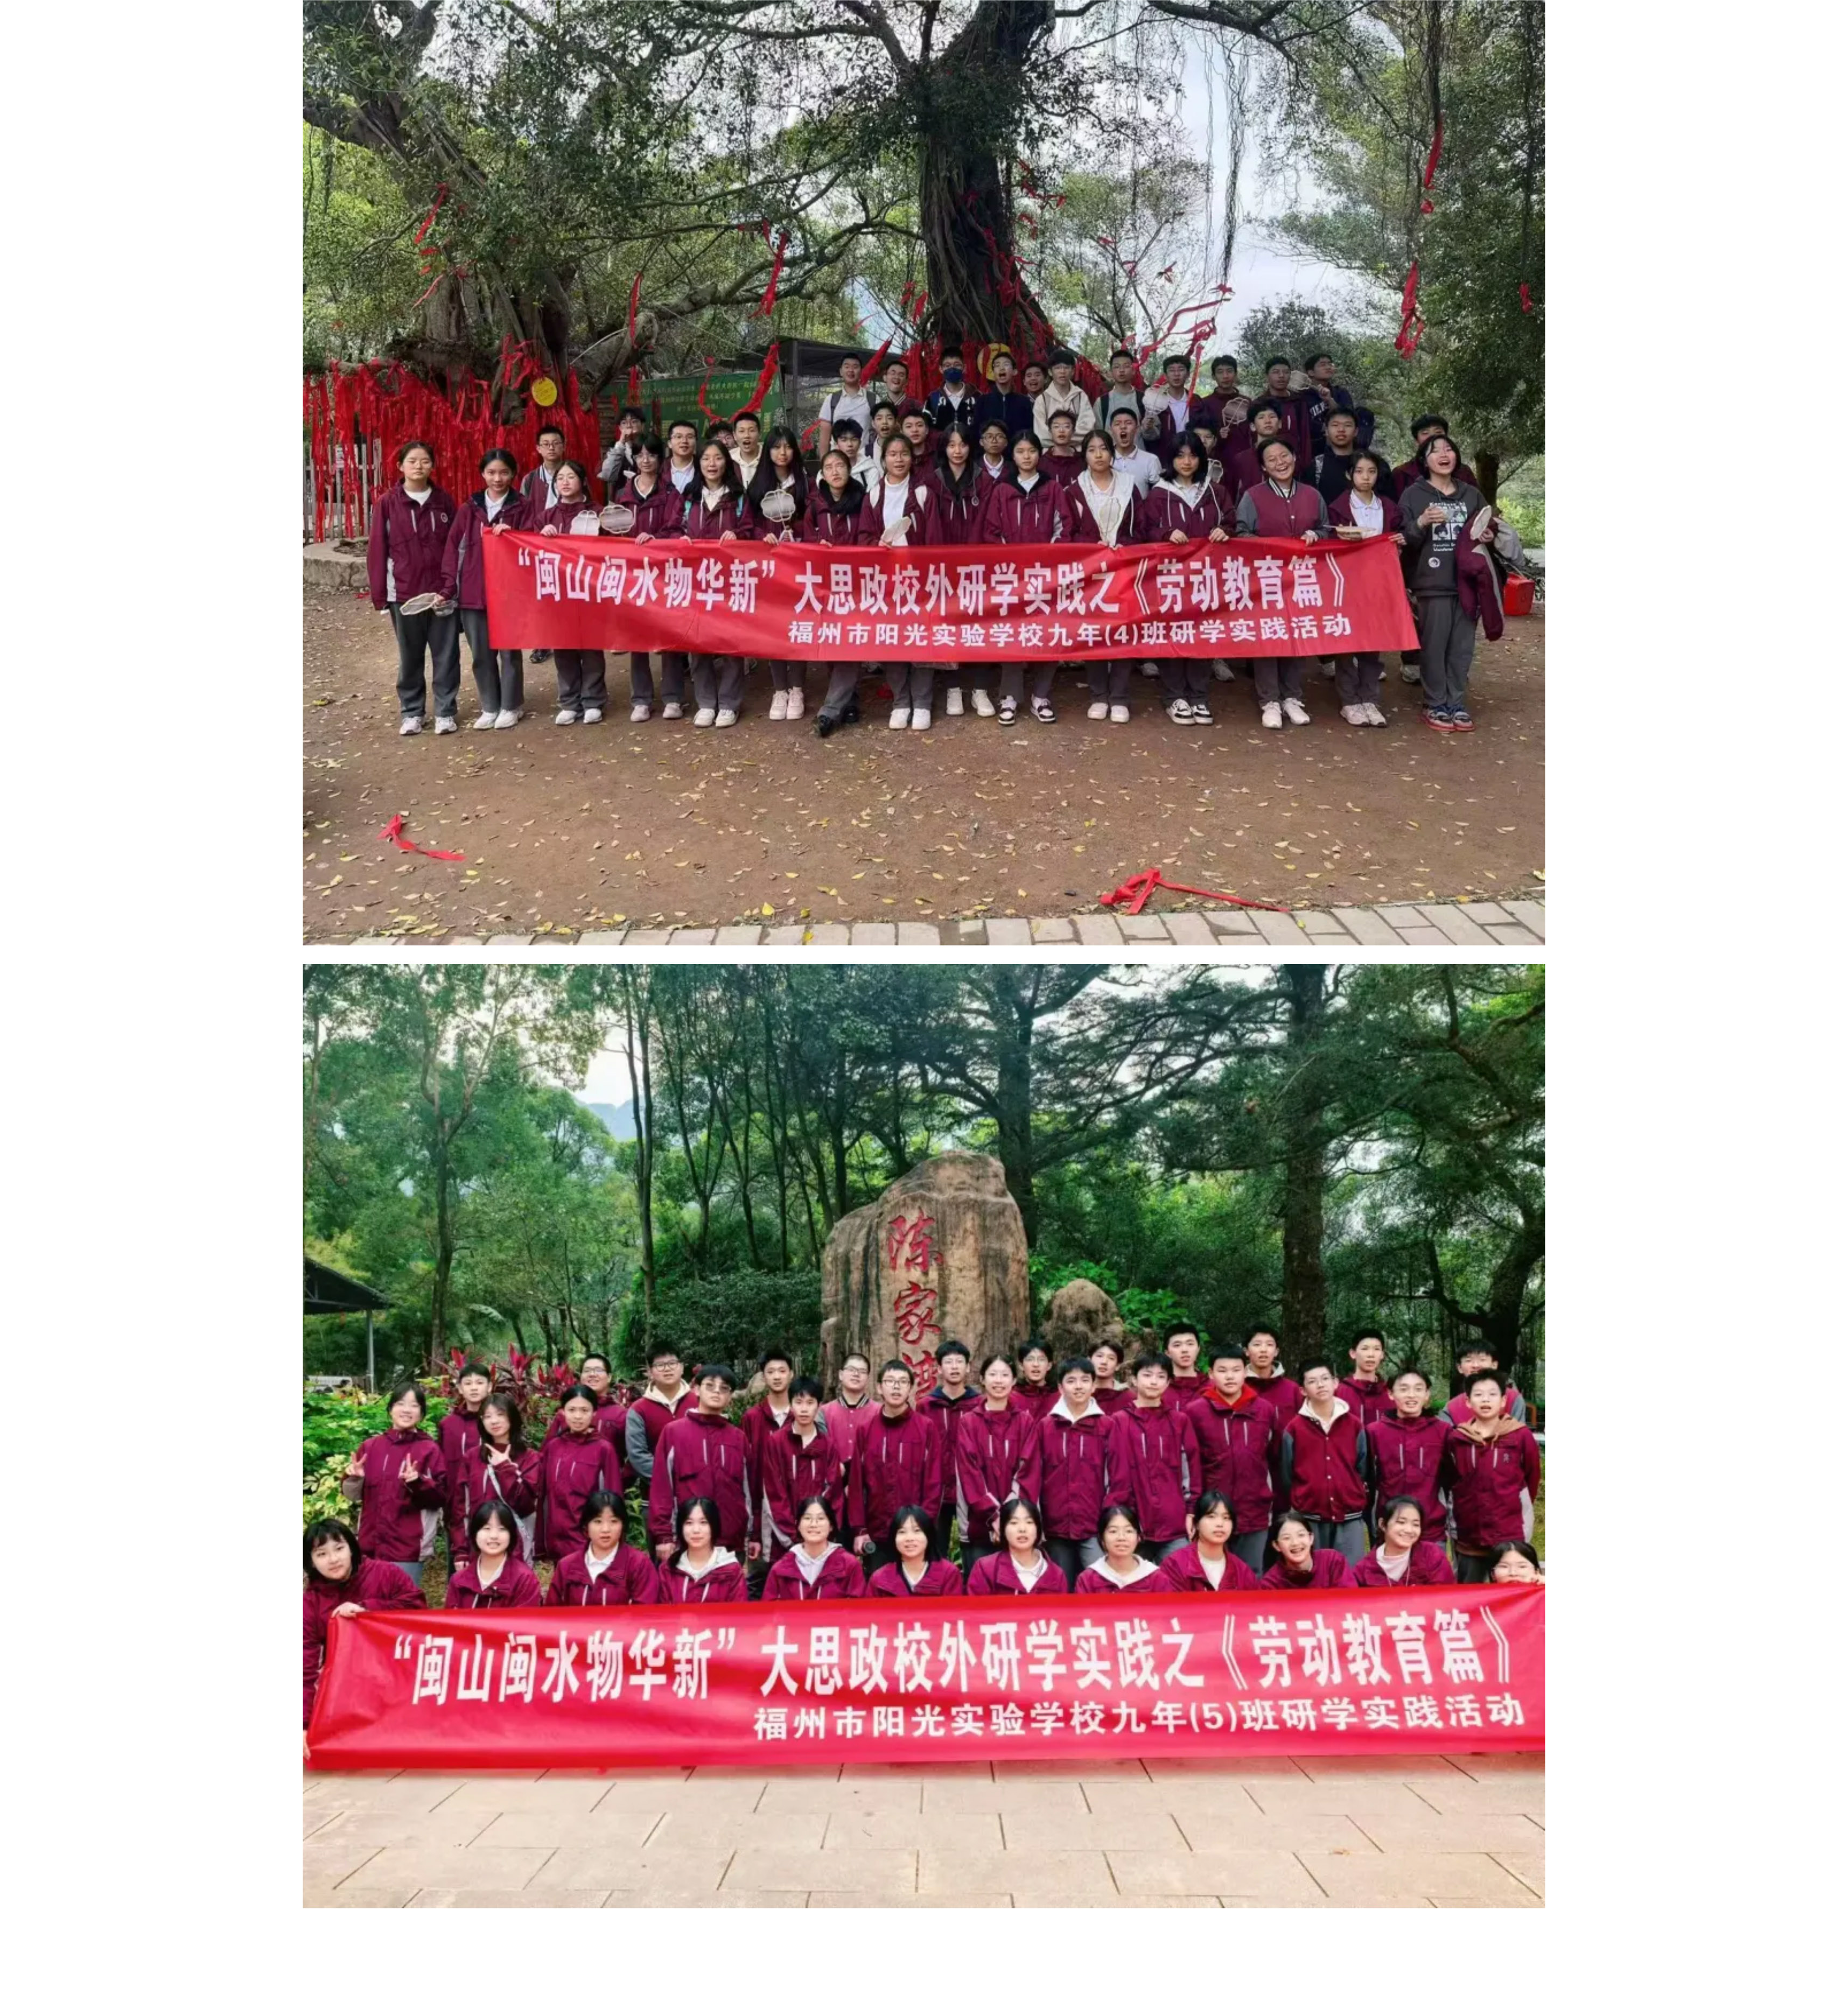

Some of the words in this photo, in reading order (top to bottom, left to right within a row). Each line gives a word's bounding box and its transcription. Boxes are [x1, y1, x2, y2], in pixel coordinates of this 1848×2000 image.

[788, 613, 1352, 647] 福州市阳光实验学校九年(4)班研学实践活动
[754, 1692, 1525, 1741] 福州市阳光实验学校九年(5)班研学实践活动
